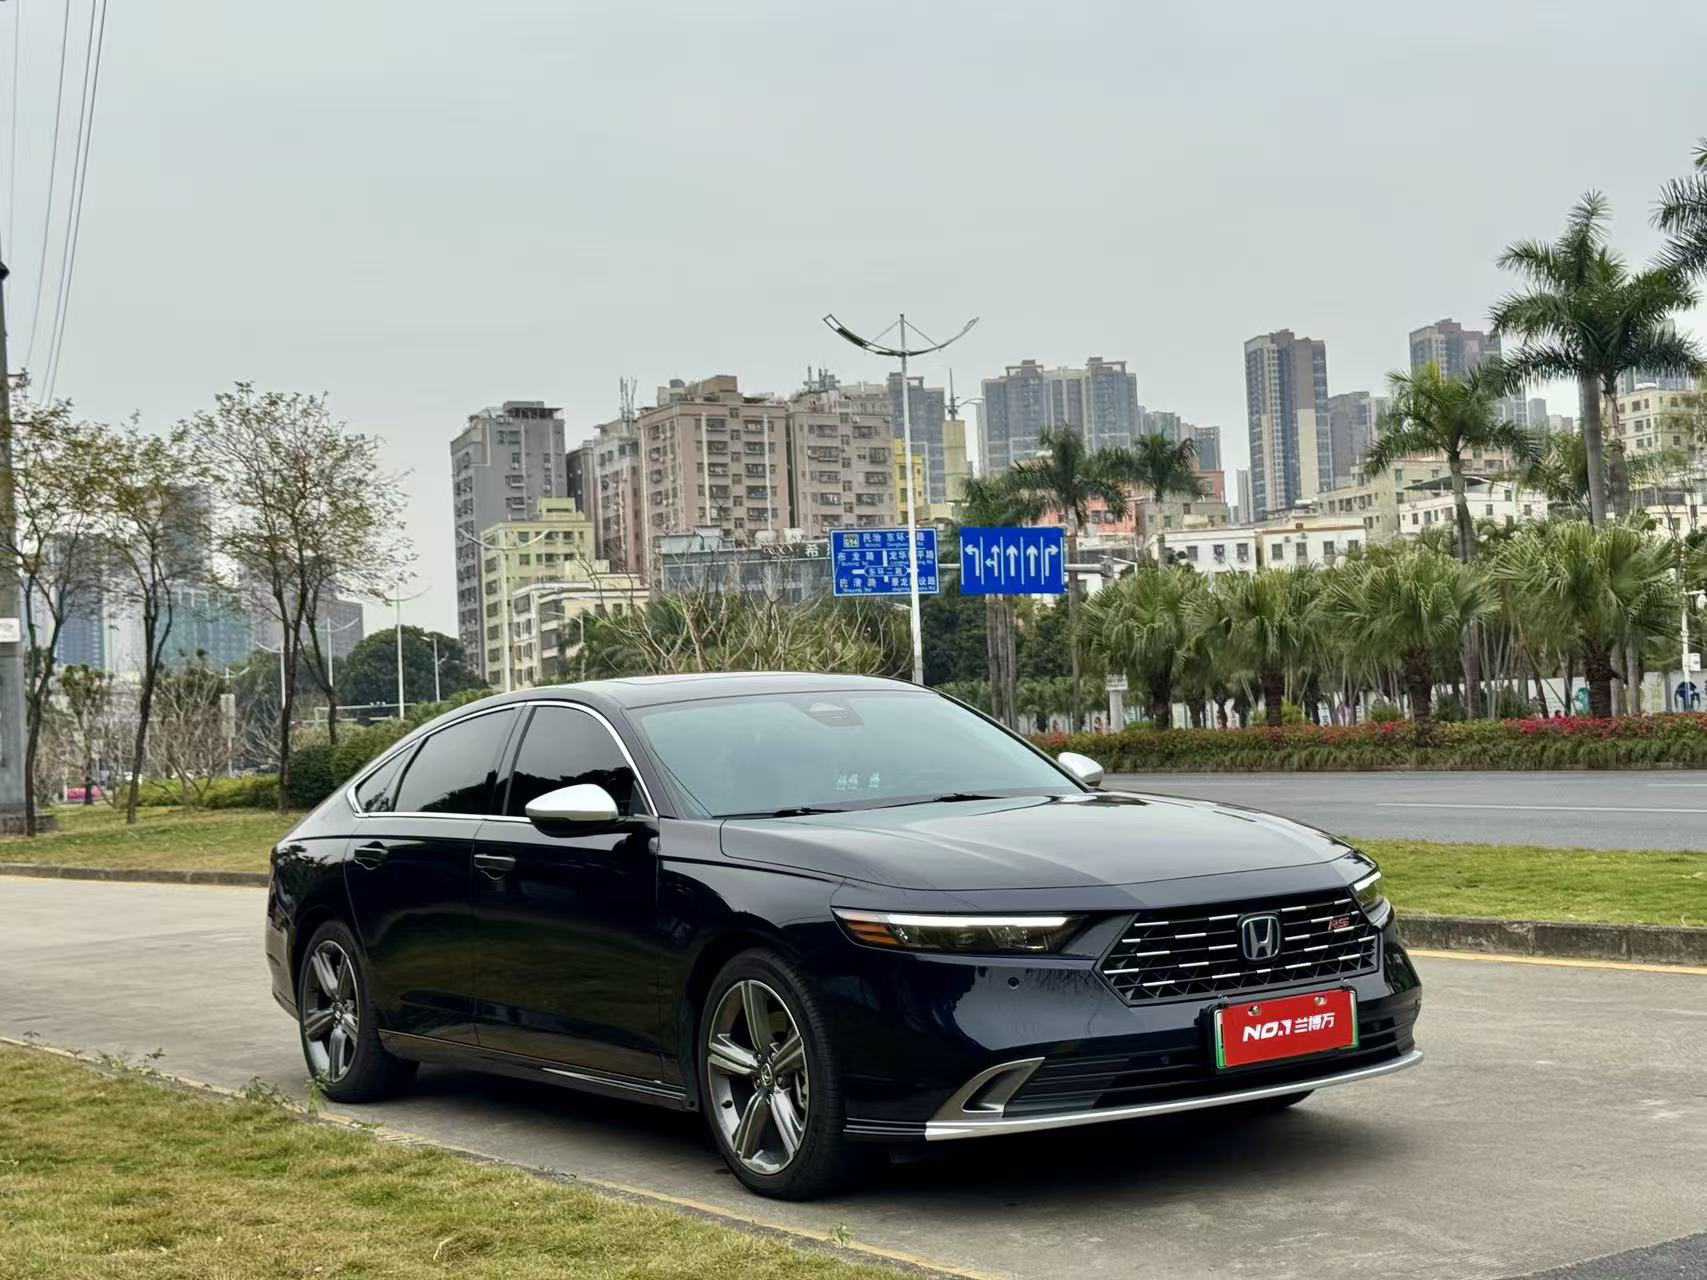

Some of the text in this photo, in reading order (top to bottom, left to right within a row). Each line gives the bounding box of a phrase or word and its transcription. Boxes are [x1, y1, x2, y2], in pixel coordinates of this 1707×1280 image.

[889, 550, 934, 560] 龙华平路
[891, 576, 936, 587] 景龙设路
[1243, 1019, 1292, 1042] NO.1
